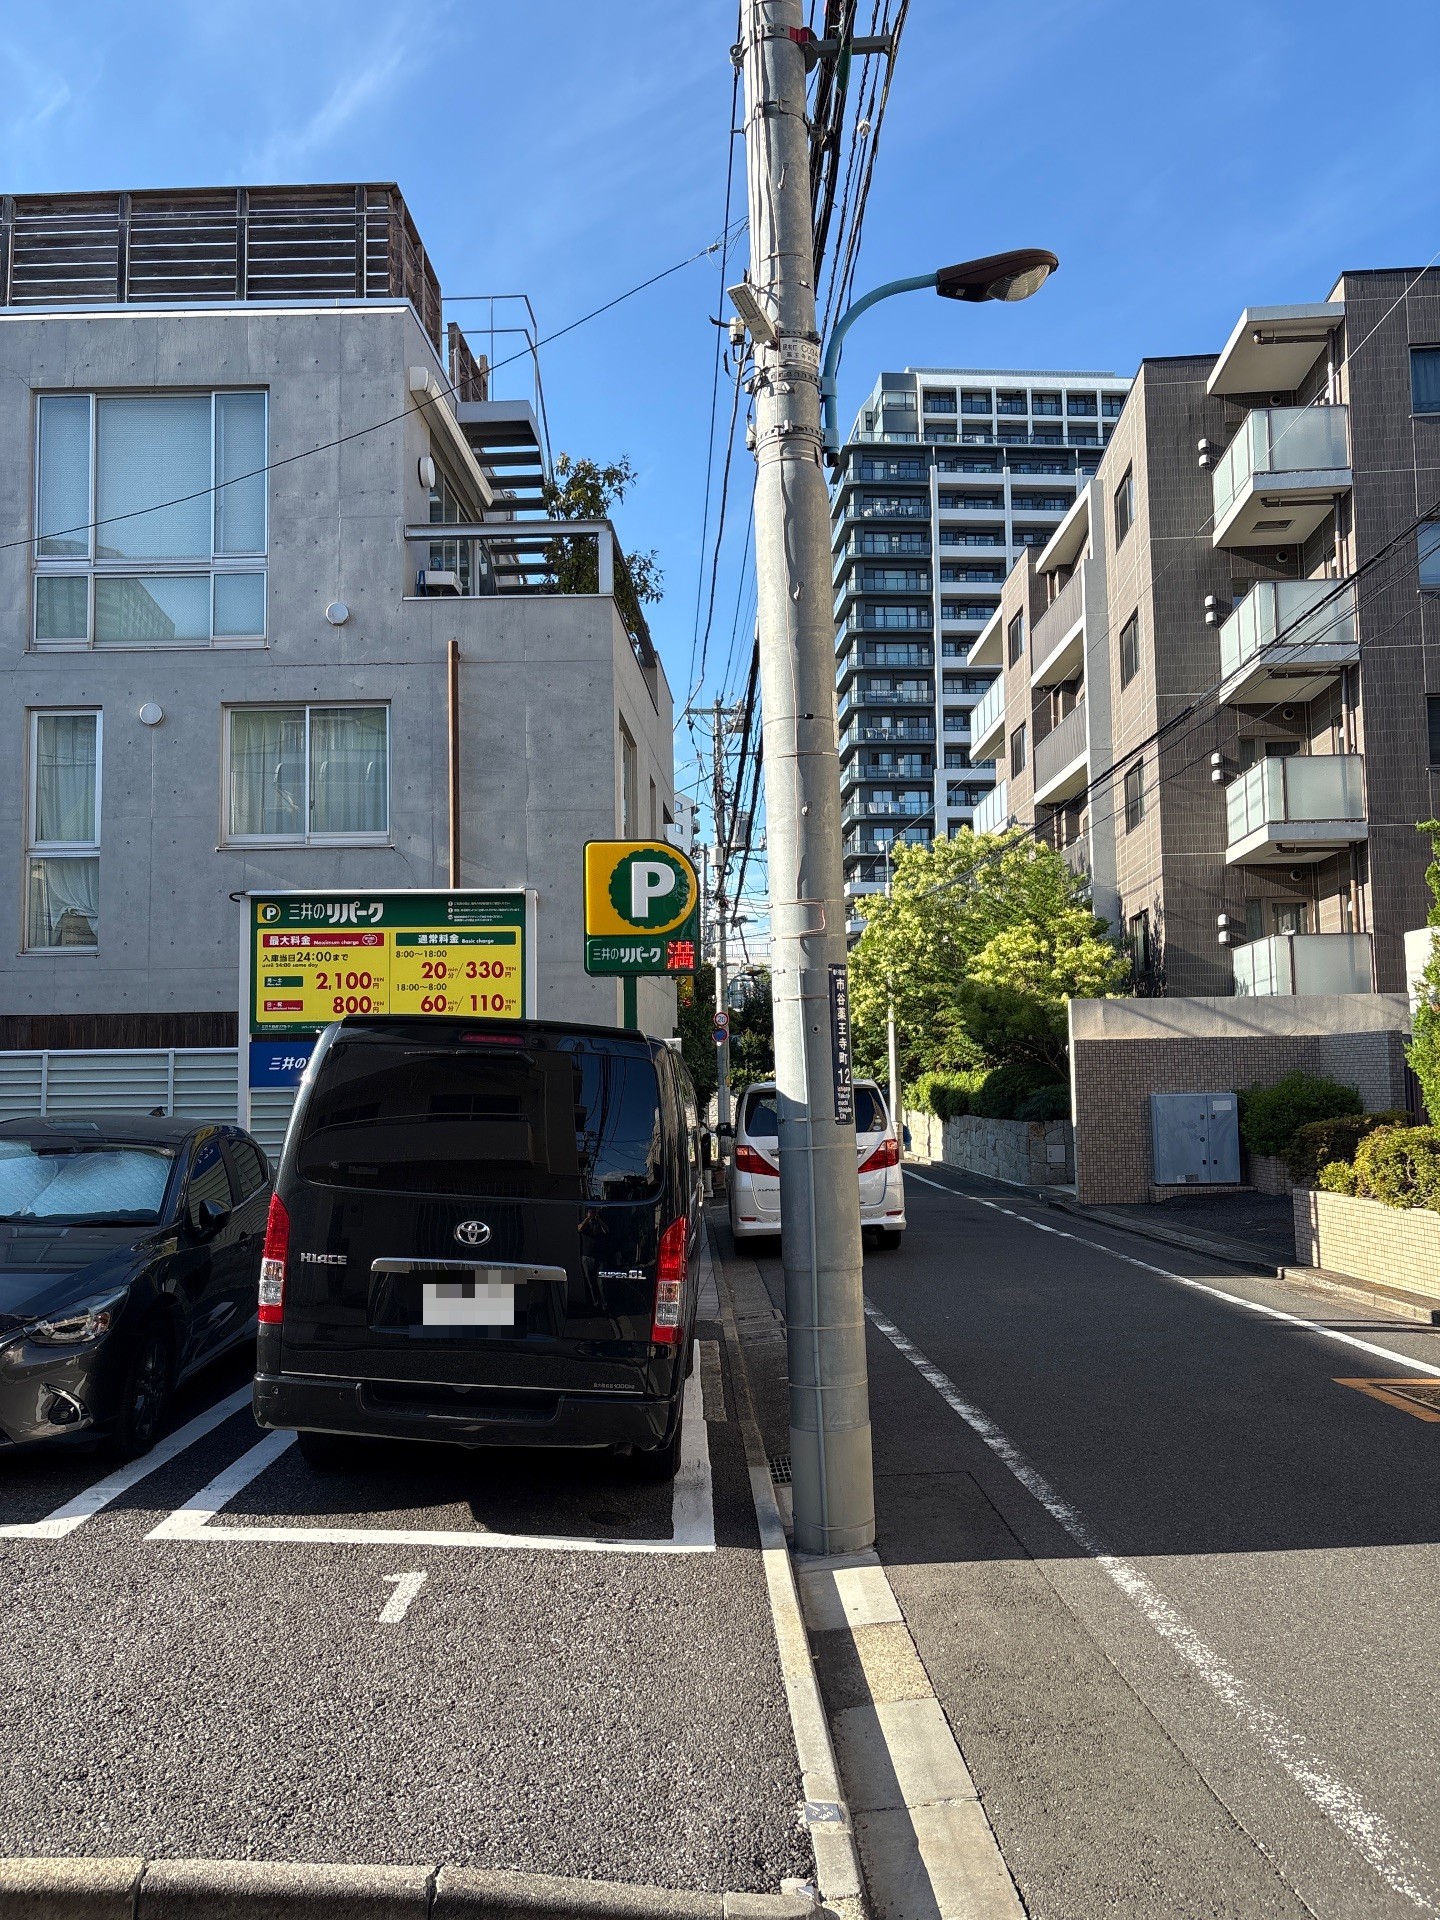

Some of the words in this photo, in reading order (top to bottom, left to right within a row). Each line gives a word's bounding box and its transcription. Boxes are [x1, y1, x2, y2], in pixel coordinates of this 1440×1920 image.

[632, 861, 676, 918] P
[266, 907, 277, 920] P
[288, 901, 384, 924] 三井のリパーク
[269, 935, 311, 946] 最大料金
[418, 934, 460, 944] 通常料金
[262, 951, 349, 962] 入庫当日24:00まで
[592, 945, 661, 963] 三井のリパーク
[421, 961, 447, 979] 20
[465, 960, 504, 979] 330
[315, 971, 372, 991] 2,100
[332, 995, 372, 1014] 800
[420, 995, 447, 1013] 60
[470, 994, 504, 1012] 110
[835, 977, 848, 1065] 市谷薬王寺町
[837, 1067, 851, 1084] 12
[300, 1252, 348, 1265] HIACE
[597, 1271, 628, 1279] SUPER
[628, 1269, 647, 1280] GL
[378, 1569, 428, 1623] 1
